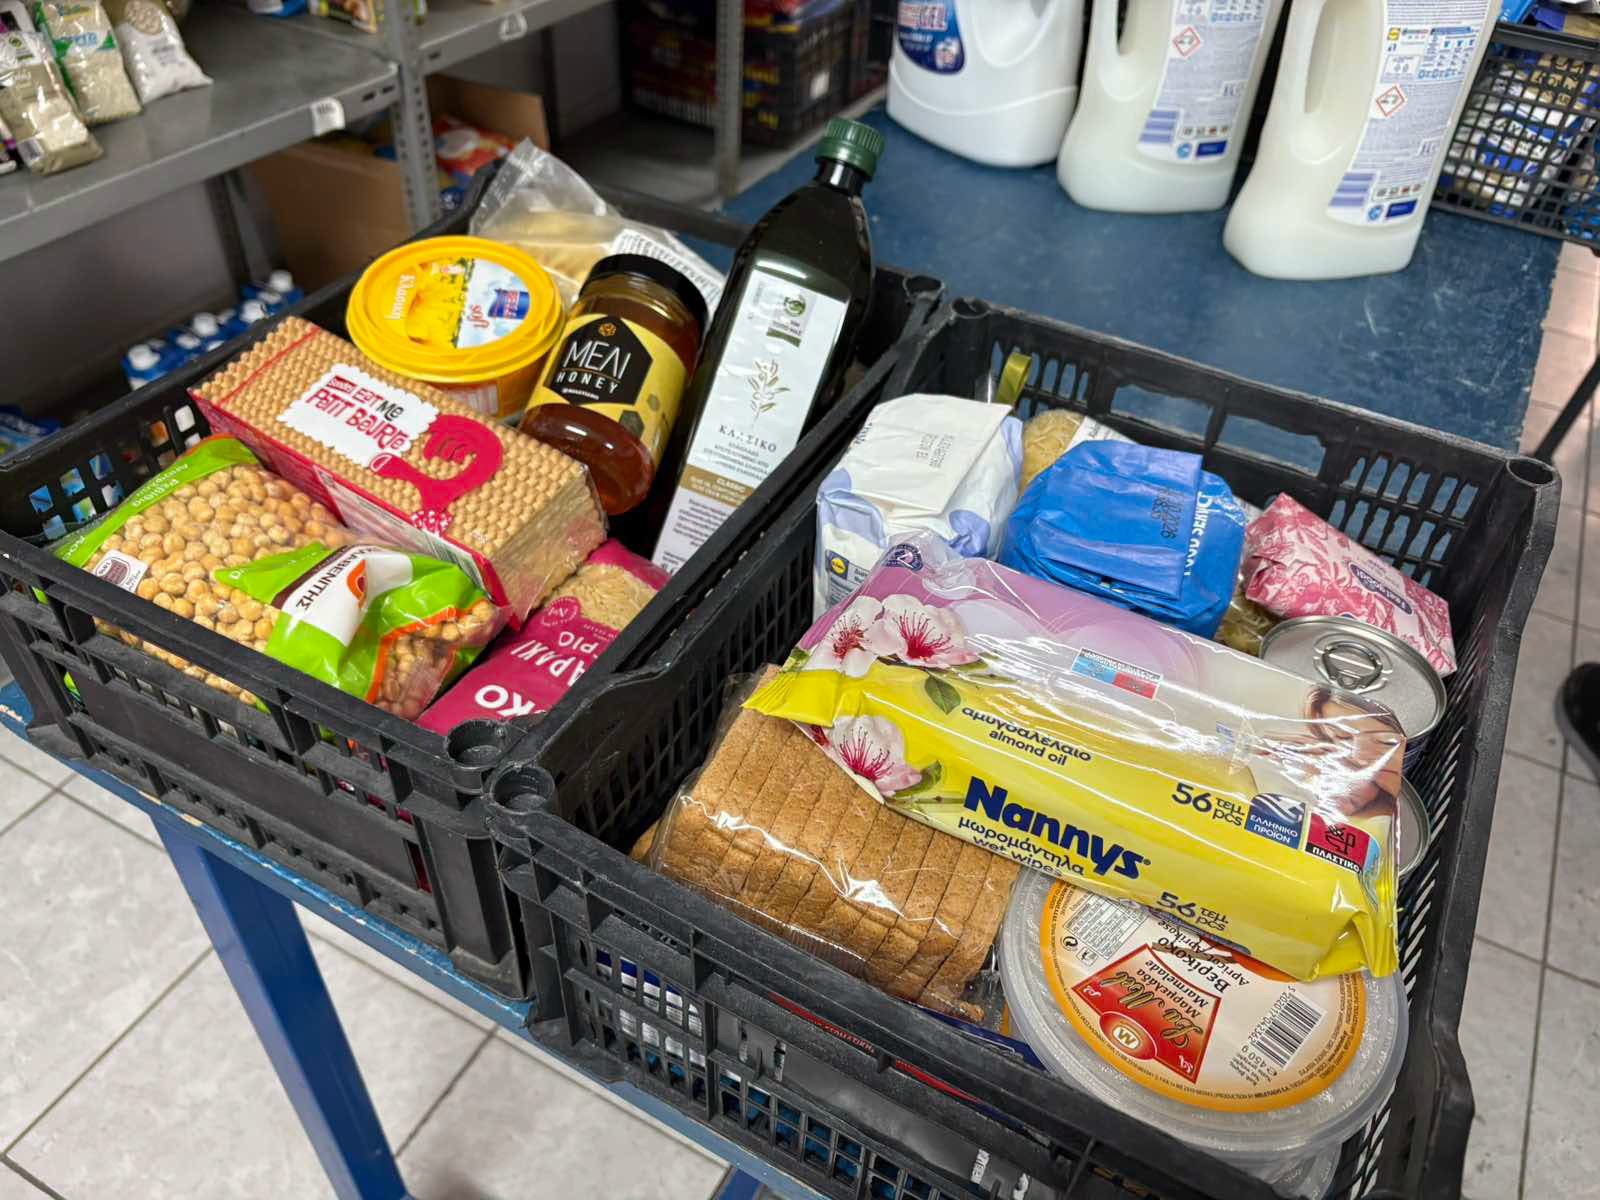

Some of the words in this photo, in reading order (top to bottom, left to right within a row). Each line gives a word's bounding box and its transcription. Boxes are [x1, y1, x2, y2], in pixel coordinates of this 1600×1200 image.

[557, 371, 618, 394] HONEY
[558, 631, 599, 659] ΡΙΟ
[962, 706, 1092, 762] αμυγδαλέλαιο
[989, 729, 1045, 757] almond
[1048, 752, 1068, 767] oil
[1171, 782, 1213, 813] 56
[963, 776, 1145, 880] Nannys
[1212, 808, 1244, 827] pcs
[1249, 814, 1298, 838] ΕΛΛΗΝΙΚΟ
[958, 816, 1085, 876] μωρομάντηλα
[973, 836, 1008, 853] wet
[1011, 850, 1064, 877] wipes
[1311, 846, 1361, 873] ΠΛΑΣΤΙΚΟ
[1156, 891, 1196, 918] 56
[1195, 916, 1226, 931] pcs
[1158, 937, 1232, 993] Βερίκοκο
[1136, 968, 1201, 1018] Μαρμελάδα
[1145, 960, 1209, 1008] Marmelade
[1241, 1044, 1249, 1053] g
[1248, 1052, 1268, 1068] 450
